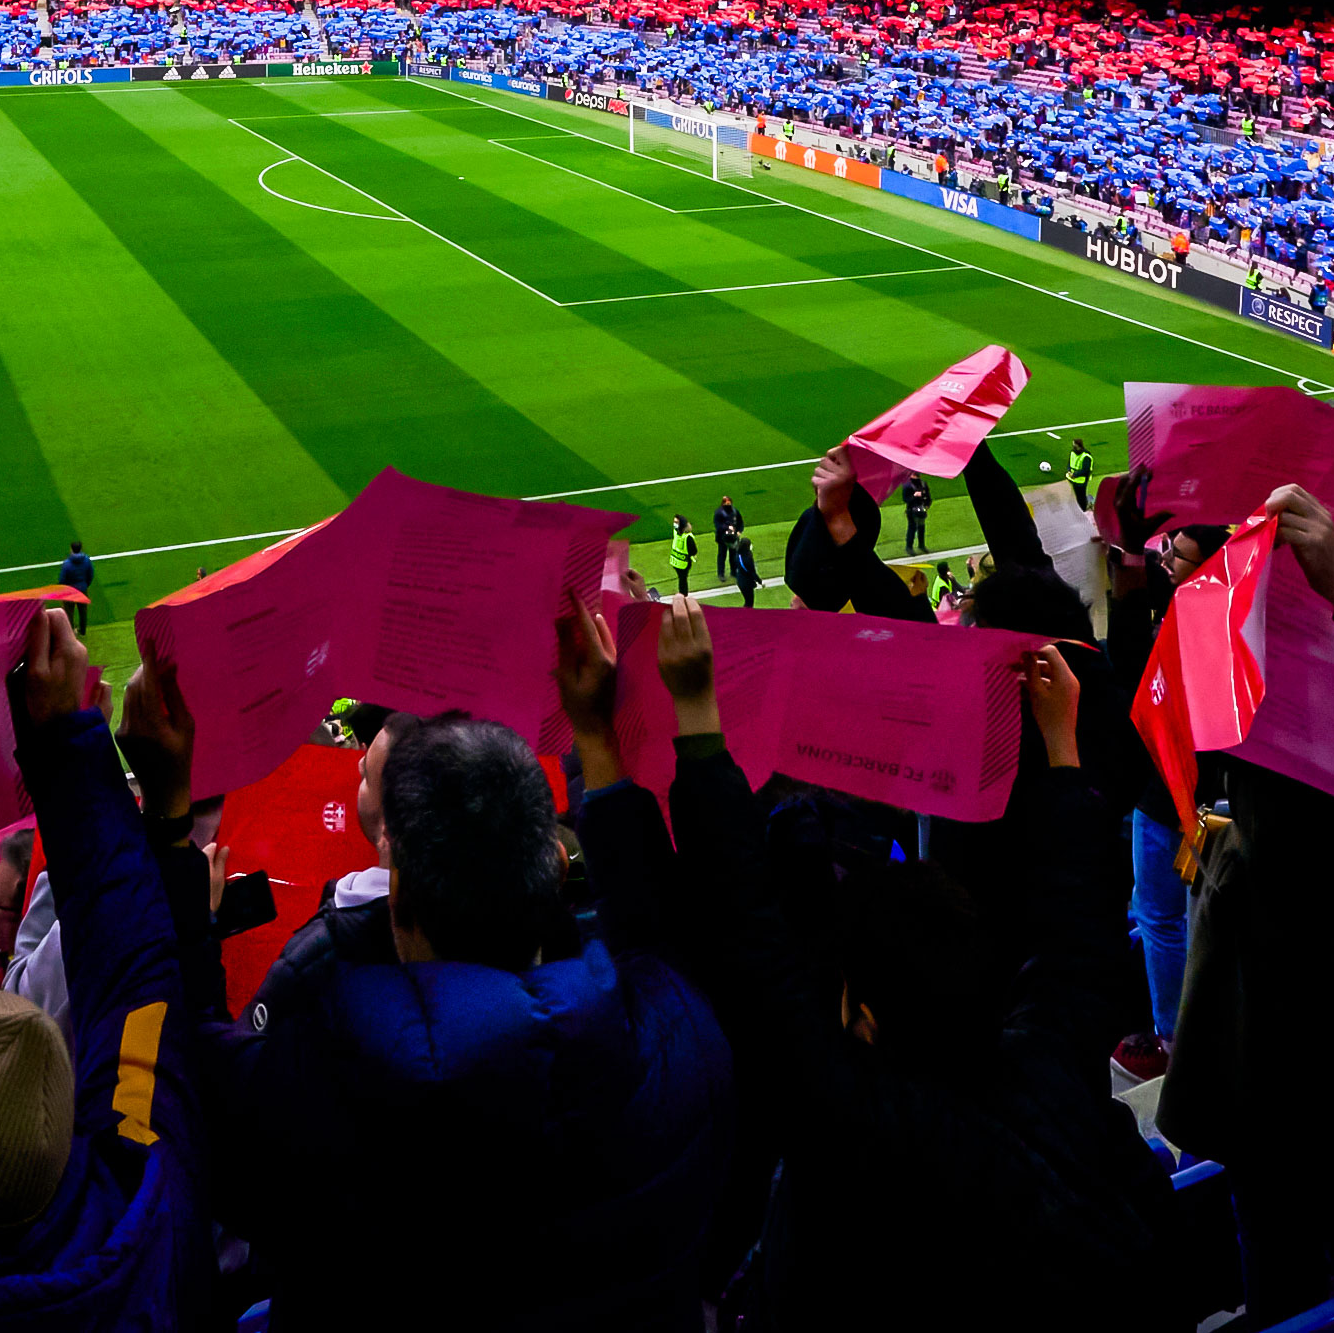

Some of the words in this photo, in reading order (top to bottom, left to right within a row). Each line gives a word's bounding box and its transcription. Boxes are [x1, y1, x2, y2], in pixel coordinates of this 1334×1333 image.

[29, 68, 93, 86] GRIFOLS
[292, 62, 359, 77] Heineken
[418, 67, 442, 76] RESPECT
[462, 70, 493, 84] euronics
[511, 78, 541, 92] euronics
[575, 92, 607, 113] pepsi
[607, 98, 628, 116] MAX
[939, 186, 979, 218] VISA
[1086, 235, 1183, 289] HUBLOT
[1268, 303, 1323, 336] RESPECT
[796, 741, 900, 777] BARCELONA
[904, 764, 924, 782] FC
